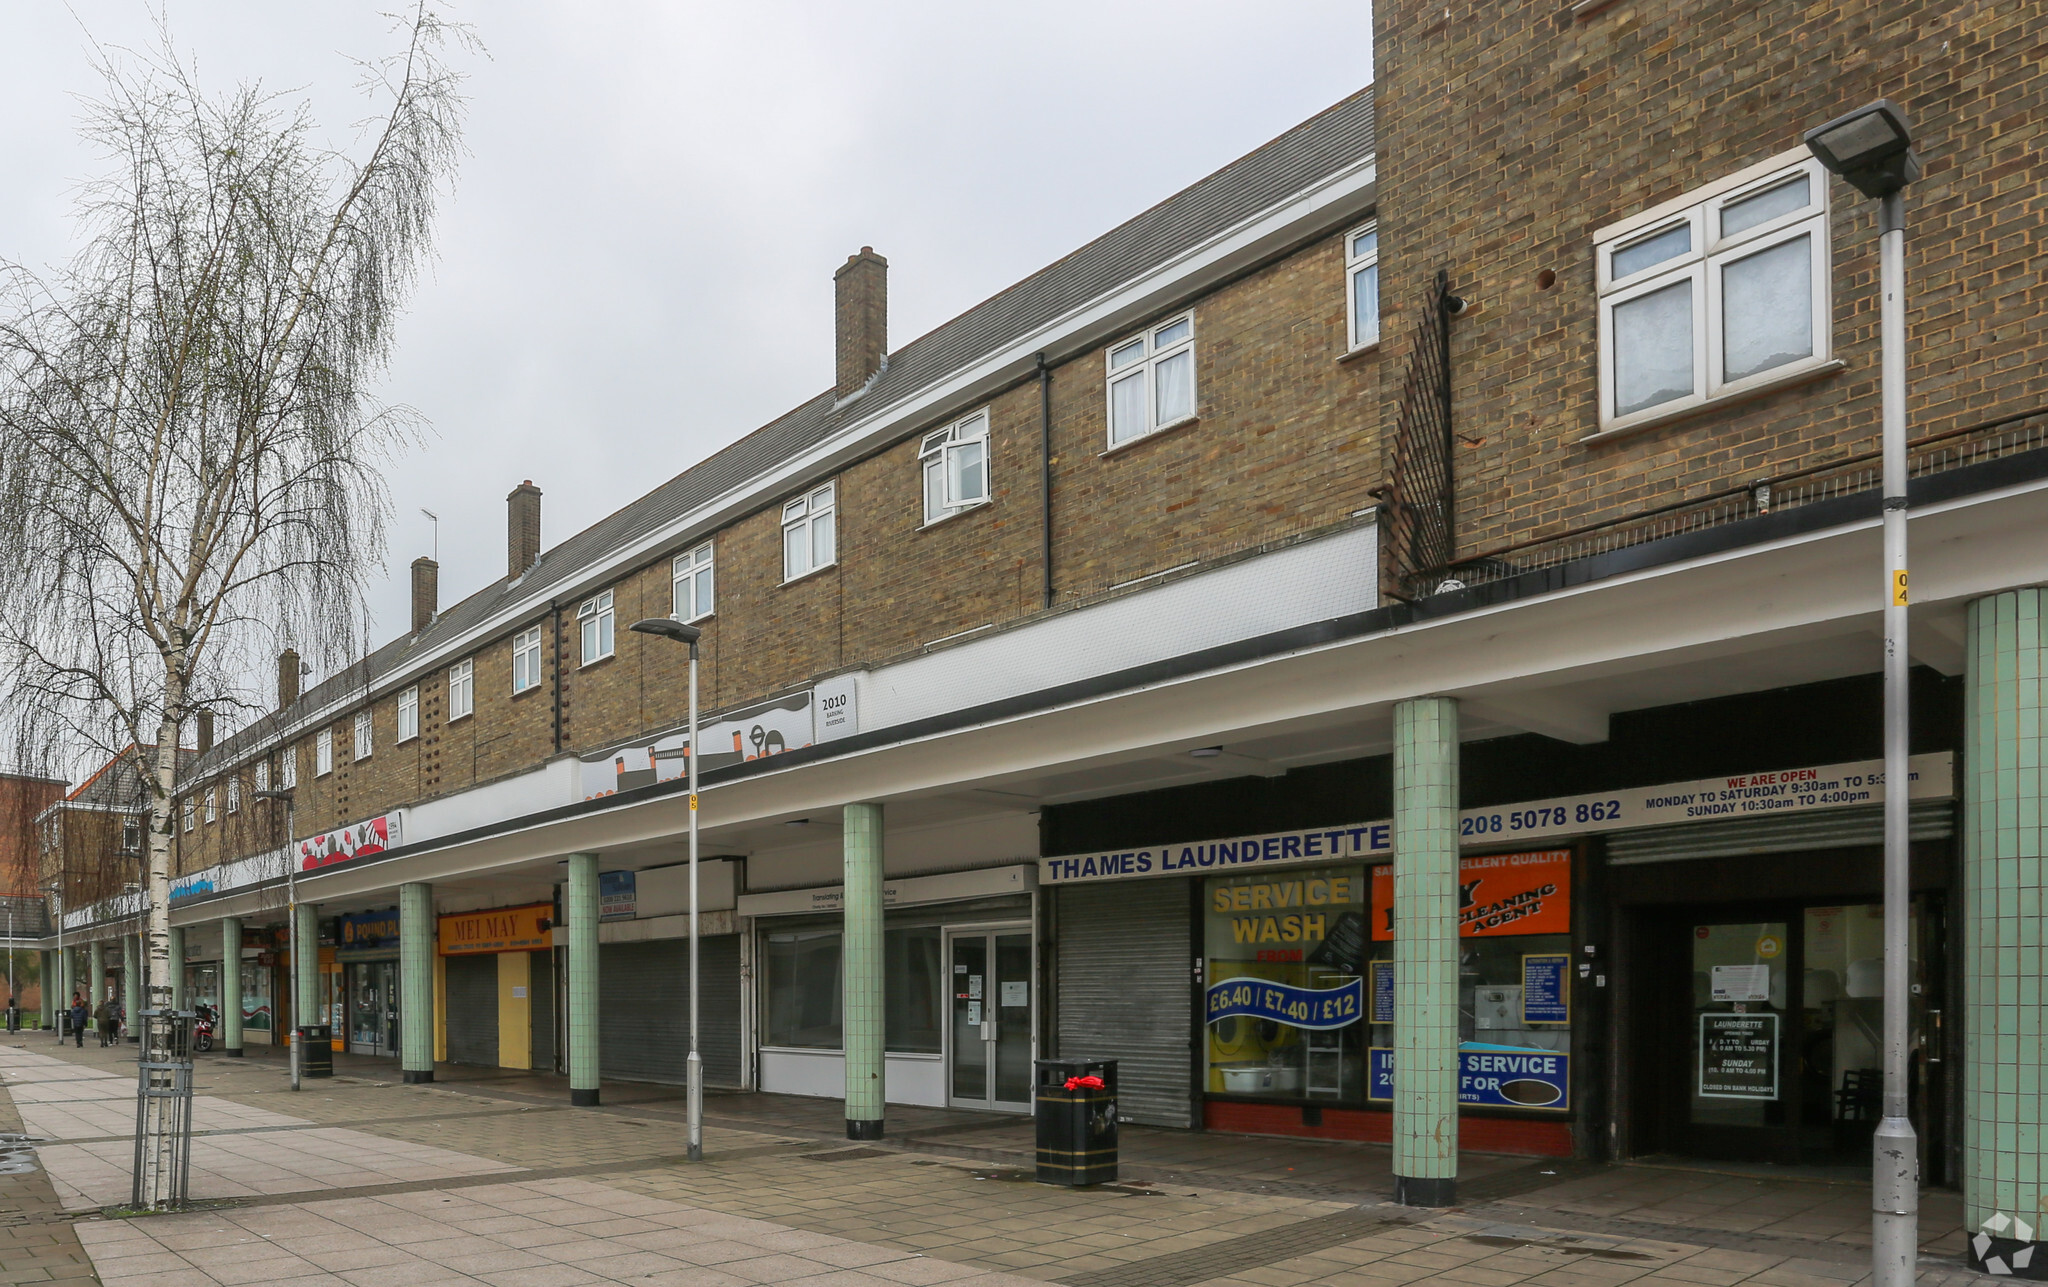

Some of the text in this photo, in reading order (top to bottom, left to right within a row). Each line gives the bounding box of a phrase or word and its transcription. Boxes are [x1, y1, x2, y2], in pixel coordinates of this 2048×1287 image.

[822, 694, 847, 711] 2010
[825, 717, 846, 727] RIVERSIDE
[826, 709, 844, 719] BARKING
[1727, 769, 1817, 790] WE ARE OPEN
[1645, 771, 1919, 810] MONDAY TO SATURDAY 9:30am TO 5:3m
[1687, 789, 1870, 817] SUNDAY 10:30am TO 4:00pm
[1459, 800, 1621, 836] 208 5078 862
[1048, 824, 1391, 881] THAMES LAUNDERETTE
[1459, 855, 1508, 871] ELLENT
[1511, 850, 1570, 866] QUALITY
[1212, 875, 1351, 914] SERVICE
[454, 914, 519, 941] MEI MAY
[1231, 912, 1327, 944] WASH
[1472, 901, 1543, 934] AGENT
[1256, 948, 1304, 964] FROM
[1209, 985, 1252, 1013] £6.40
[1264, 989, 1309, 1021] £7.40
[1323, 994, 1356, 1020] £12
[1714, 1020, 1764, 1028] LAUNDERETTE
[1467, 1055, 1557, 1074] SERVICE
[1721, 1059, 1754, 1067] SUNDAY
[1462, 1076, 1500, 1090] FOR
[1747, 1085, 1774, 1093] HOLIDAYS
[1459, 1093, 1481, 1102] IRTS)
